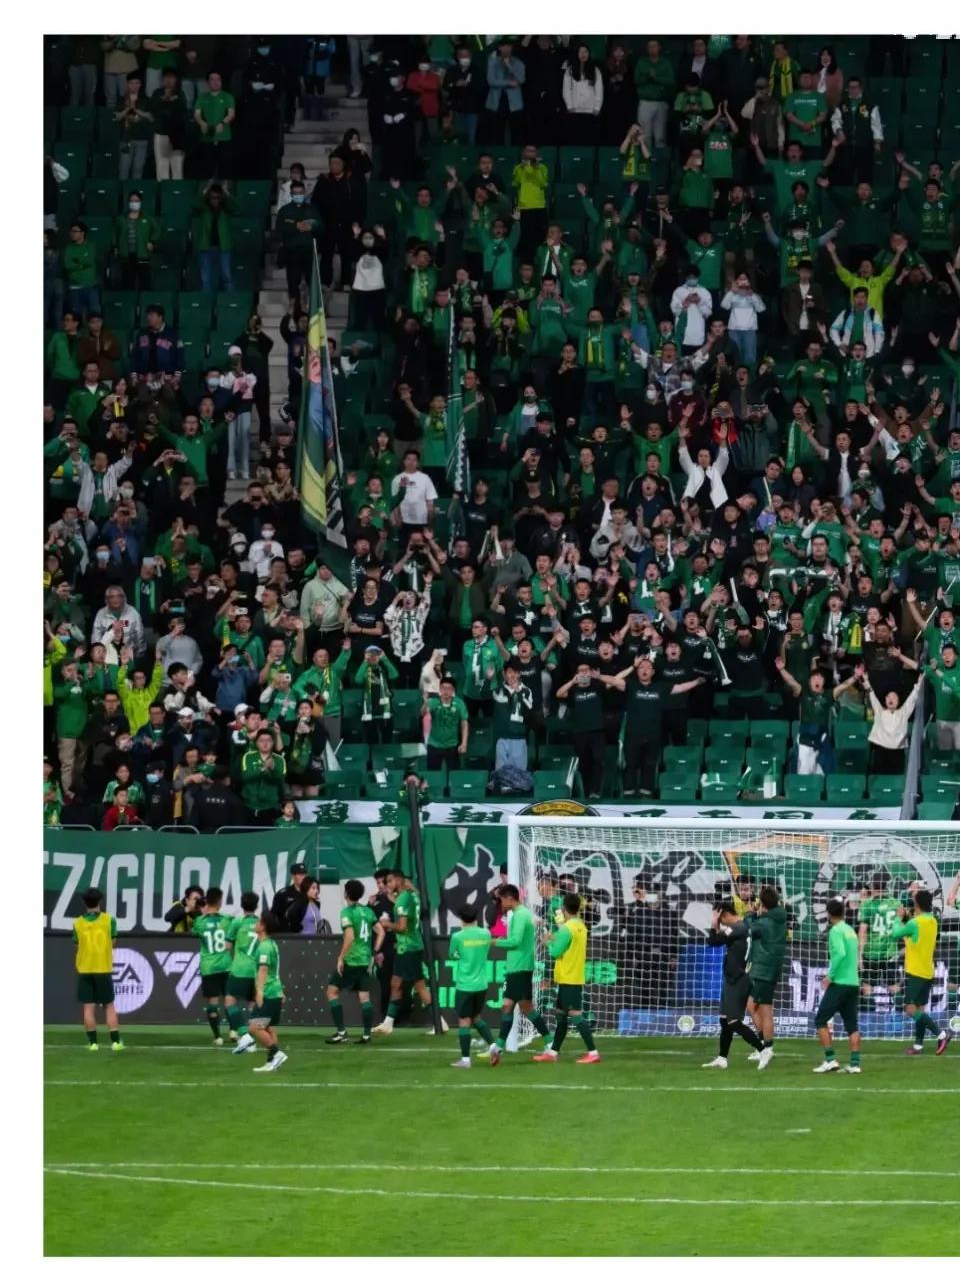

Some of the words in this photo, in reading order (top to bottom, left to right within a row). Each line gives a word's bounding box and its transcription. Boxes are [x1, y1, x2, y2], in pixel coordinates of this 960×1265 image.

[203, 928, 226, 954] 18
[359, 918, 370, 943] 4
[114, 985, 145, 996] ORTS
